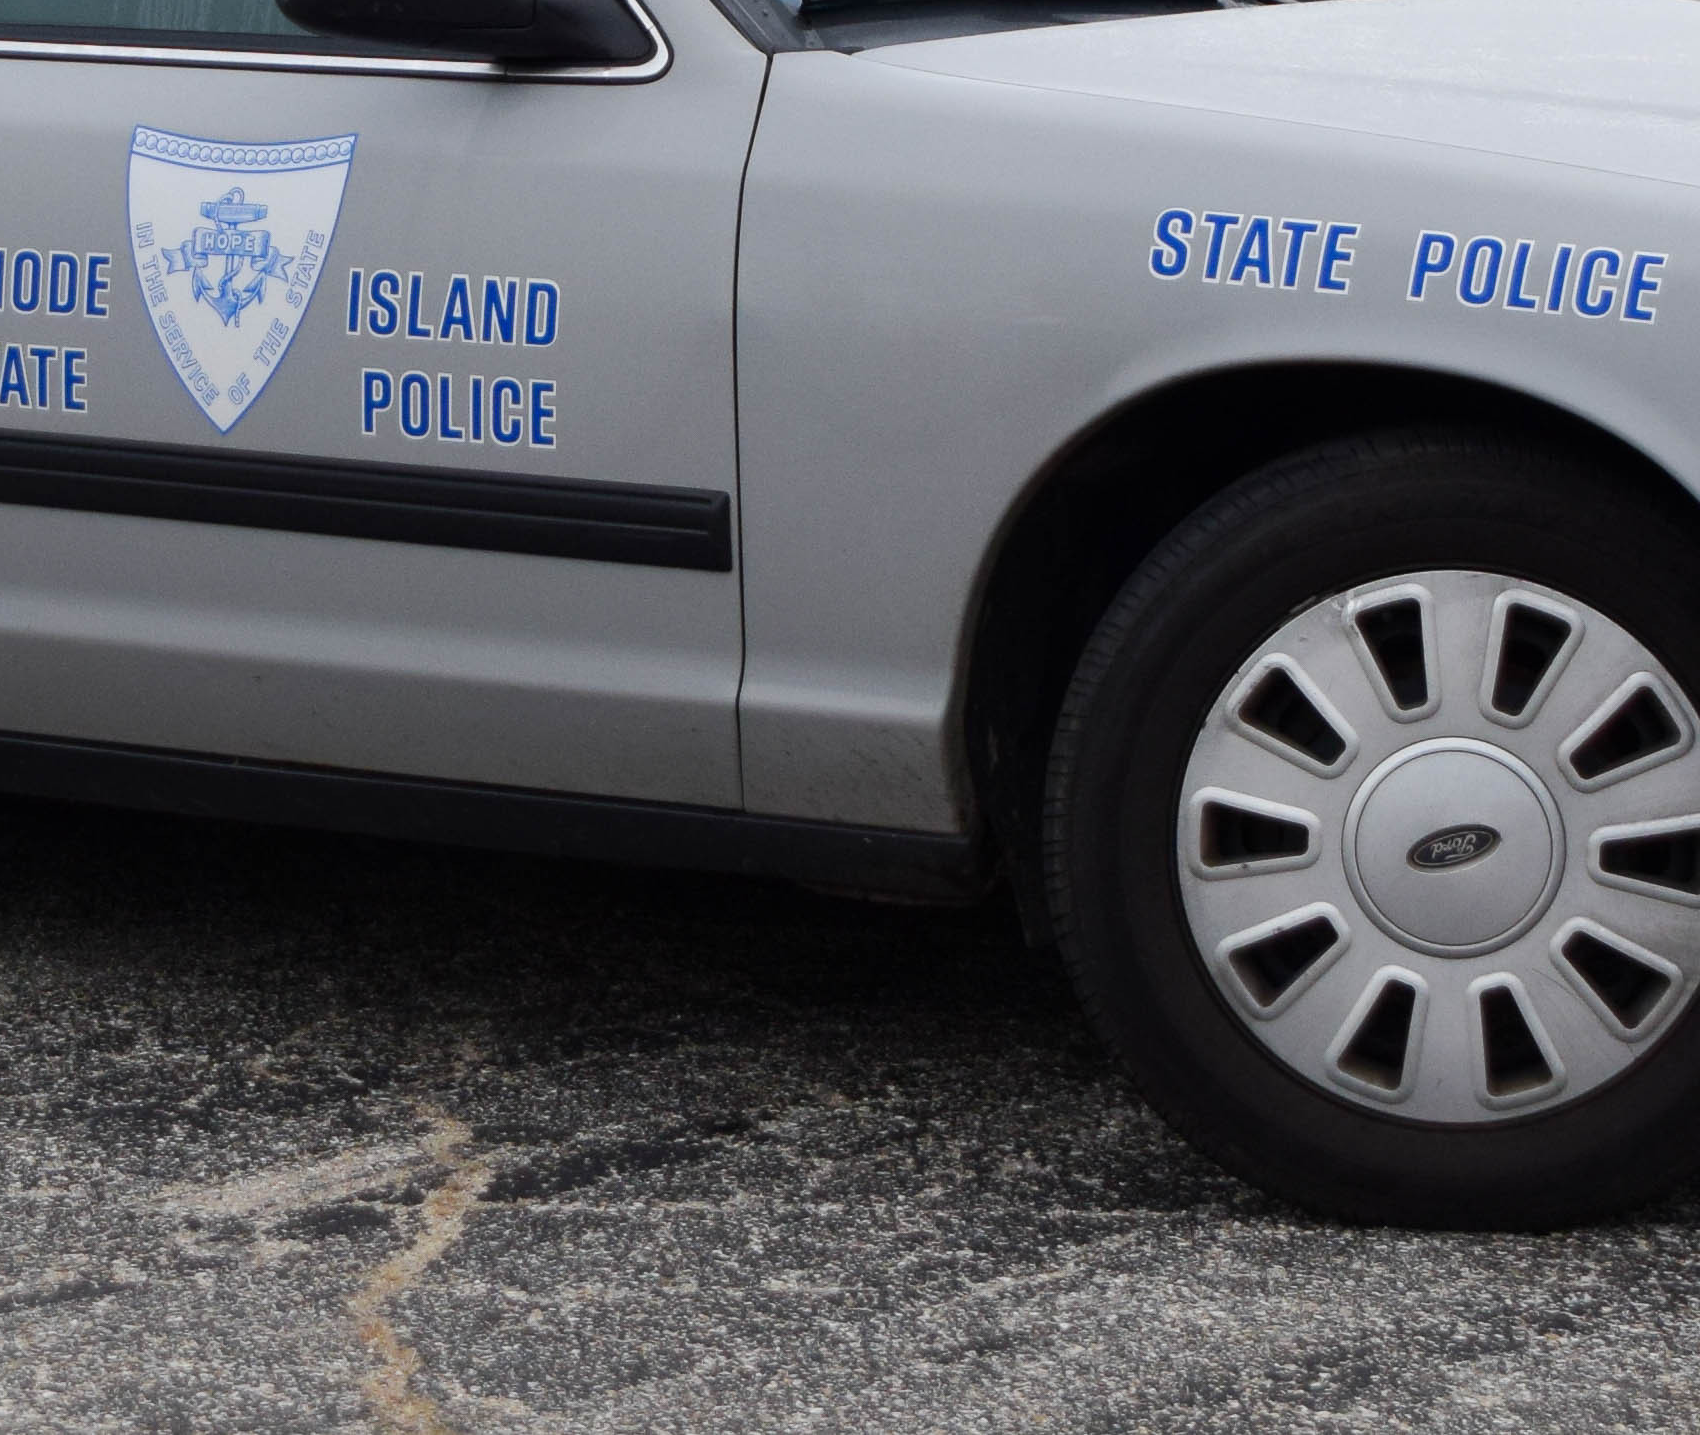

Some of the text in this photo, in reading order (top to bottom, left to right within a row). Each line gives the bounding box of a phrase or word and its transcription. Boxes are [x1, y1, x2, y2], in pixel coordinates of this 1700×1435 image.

[203, 232, 256, 252] HOPE
[1148, 207, 1669, 325] STATE POLICE
[136, 222, 325, 406] IN THE SERVICE OF THE STATE
[345, 267, 561, 347] ISLAND
[361, 367, 557, 449] POLICE
[1430, 833, 1477, 860] Ford
